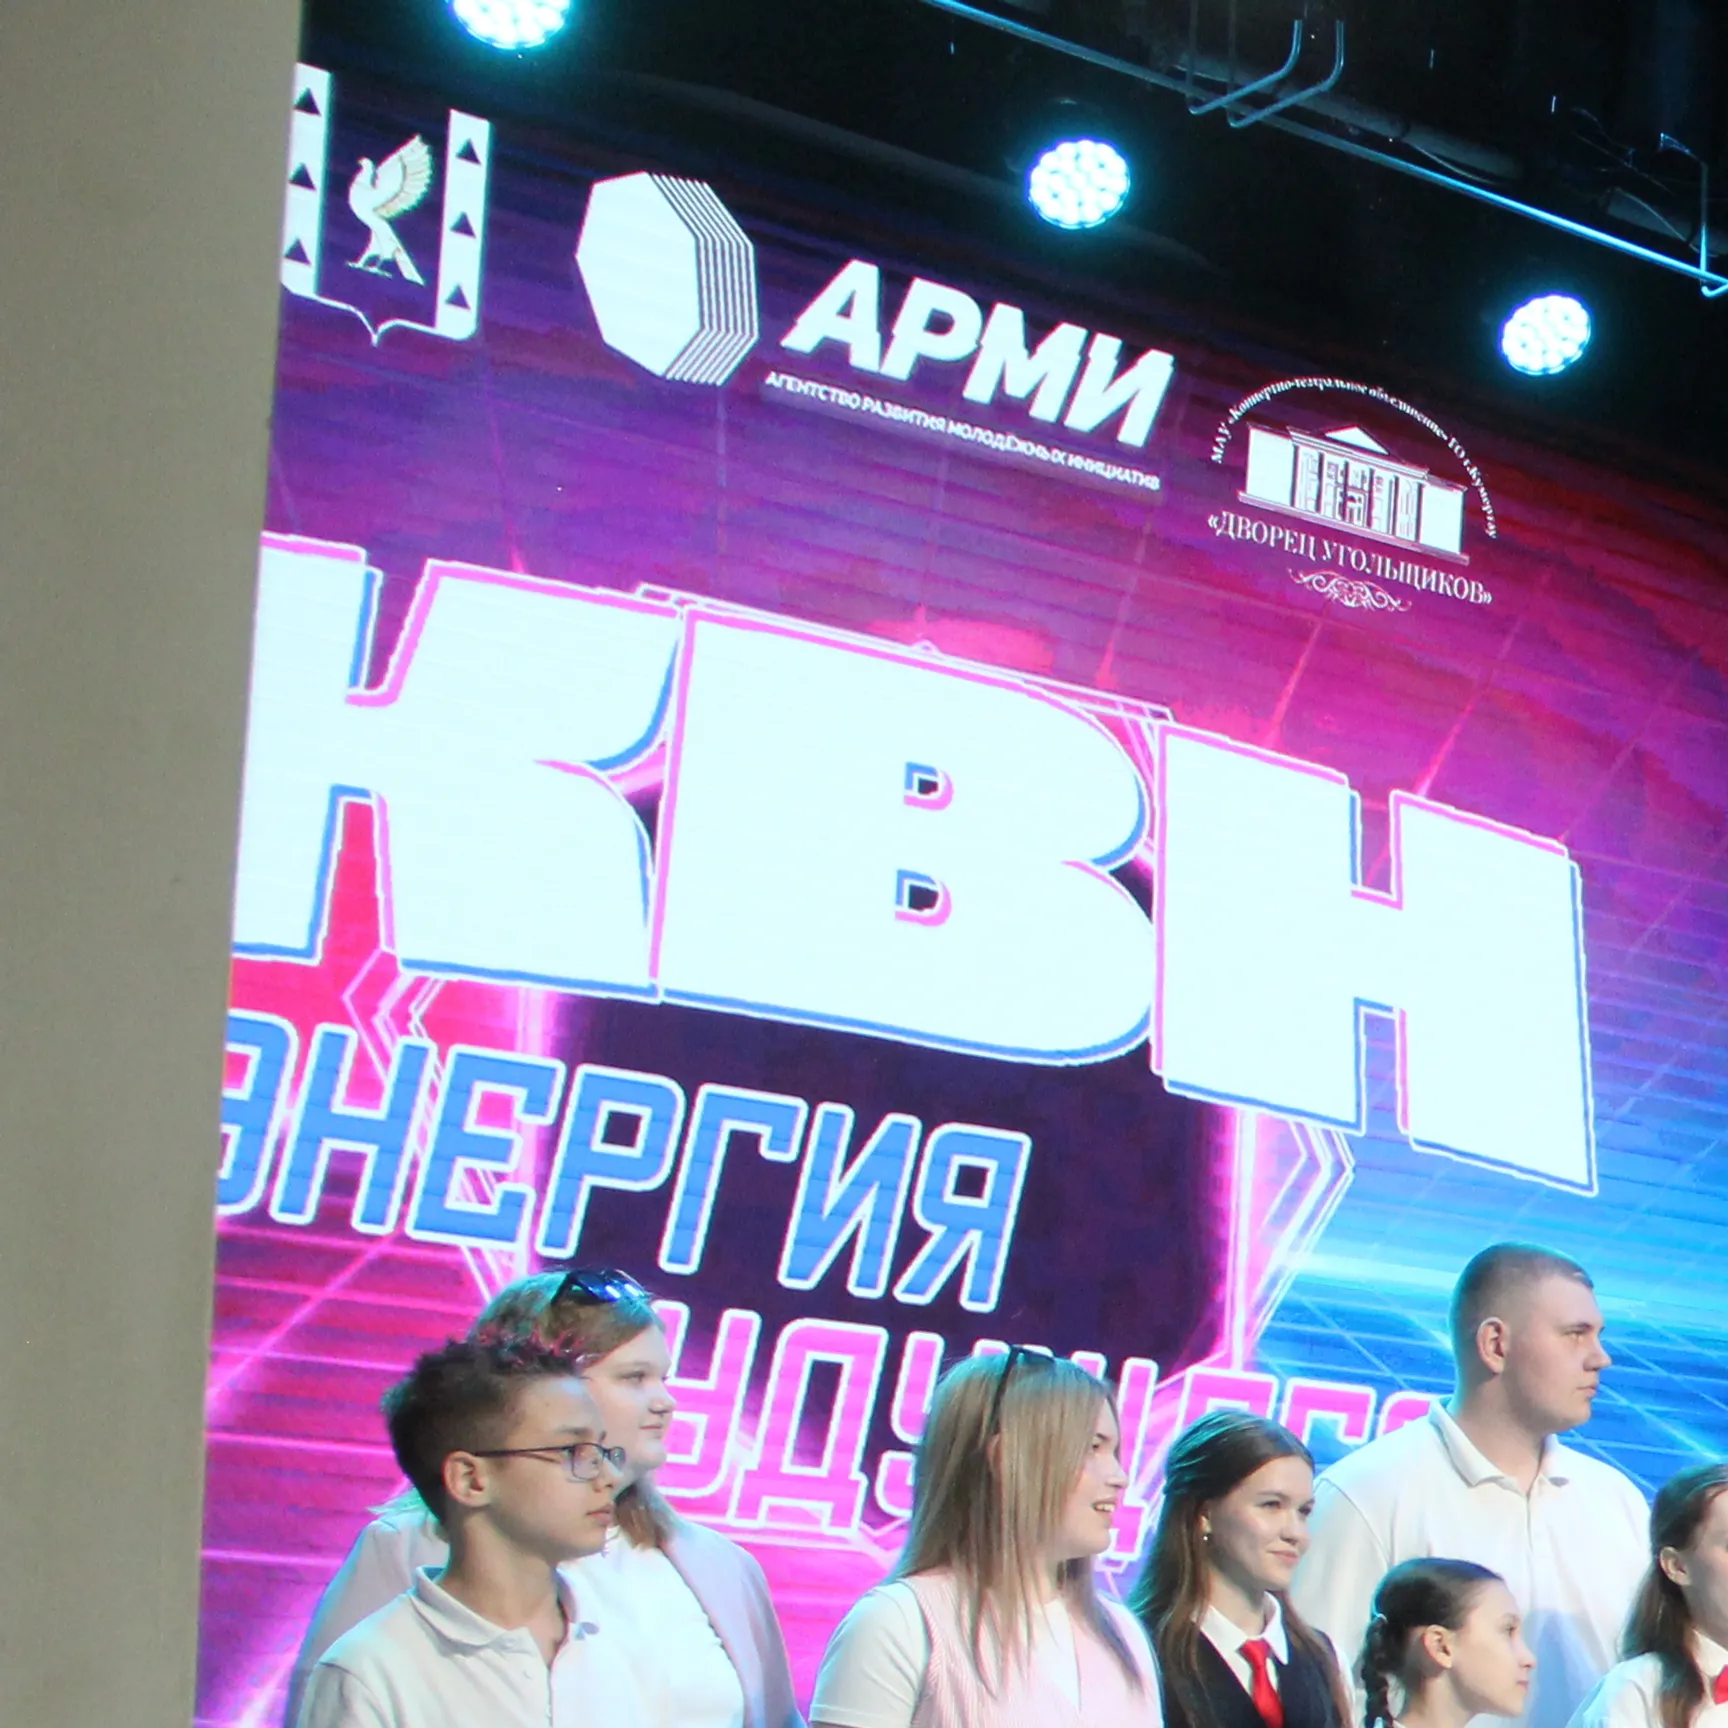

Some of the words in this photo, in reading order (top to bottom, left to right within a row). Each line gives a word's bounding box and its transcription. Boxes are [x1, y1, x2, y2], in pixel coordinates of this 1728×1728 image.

[765, 370, 862, 411] АГЕНТСТВО
[861, 394, 947, 434] РАЗВИТИЯ
[781, 258, 1175, 448] АРМИ
[1207, 510, 1317, 562] «ДВОРЕЦ
[1320, 539, 1494, 606] УГОЛЬЩИКОВ»
[233, 531, 1598, 1196] КВН
[216, 1008, 1032, 1313] ЭНЕРГИЯ
